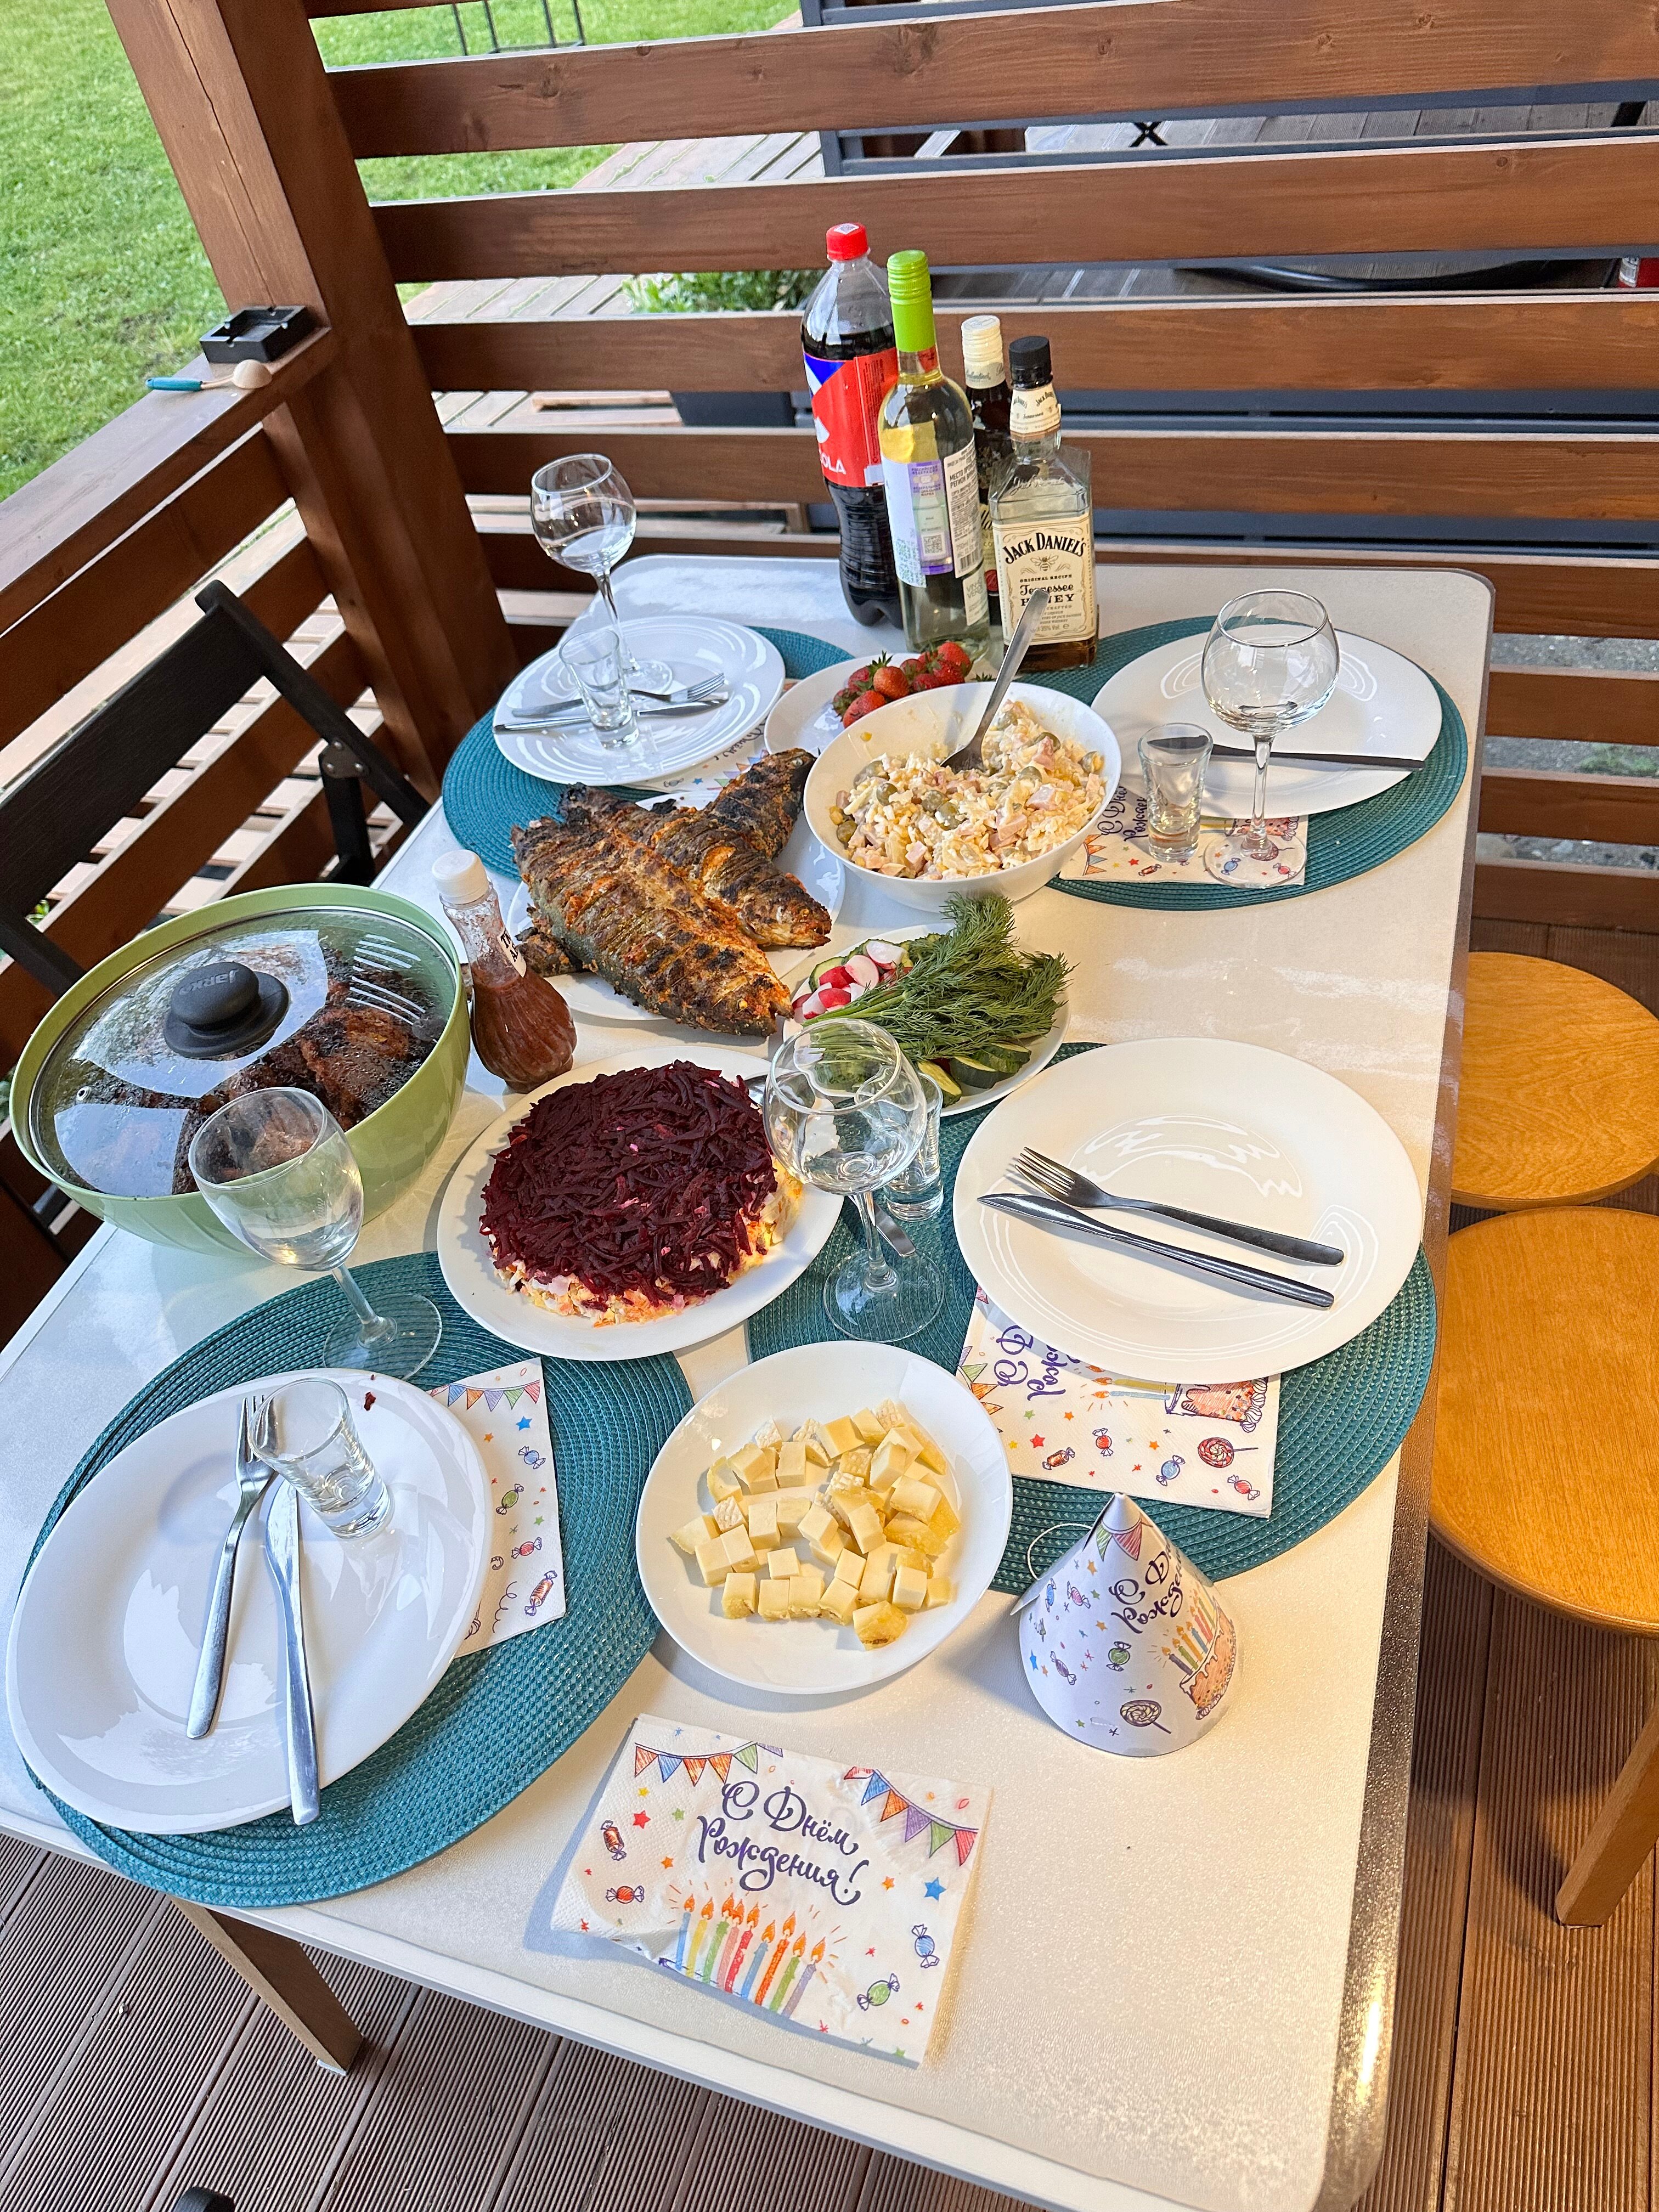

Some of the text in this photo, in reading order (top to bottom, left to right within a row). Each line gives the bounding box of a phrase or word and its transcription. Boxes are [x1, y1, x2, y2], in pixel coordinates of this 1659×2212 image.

[1002, 538, 1035, 565] JACK
[1035, 532, 1087, 557] DANIEL'S
[1020, 584, 1074, 596] Teessee
[1021, 594, 1075, 606] HEY
[721, 1781, 859, 1856] С Днём
[697, 1815, 870, 1906] Рождения!
